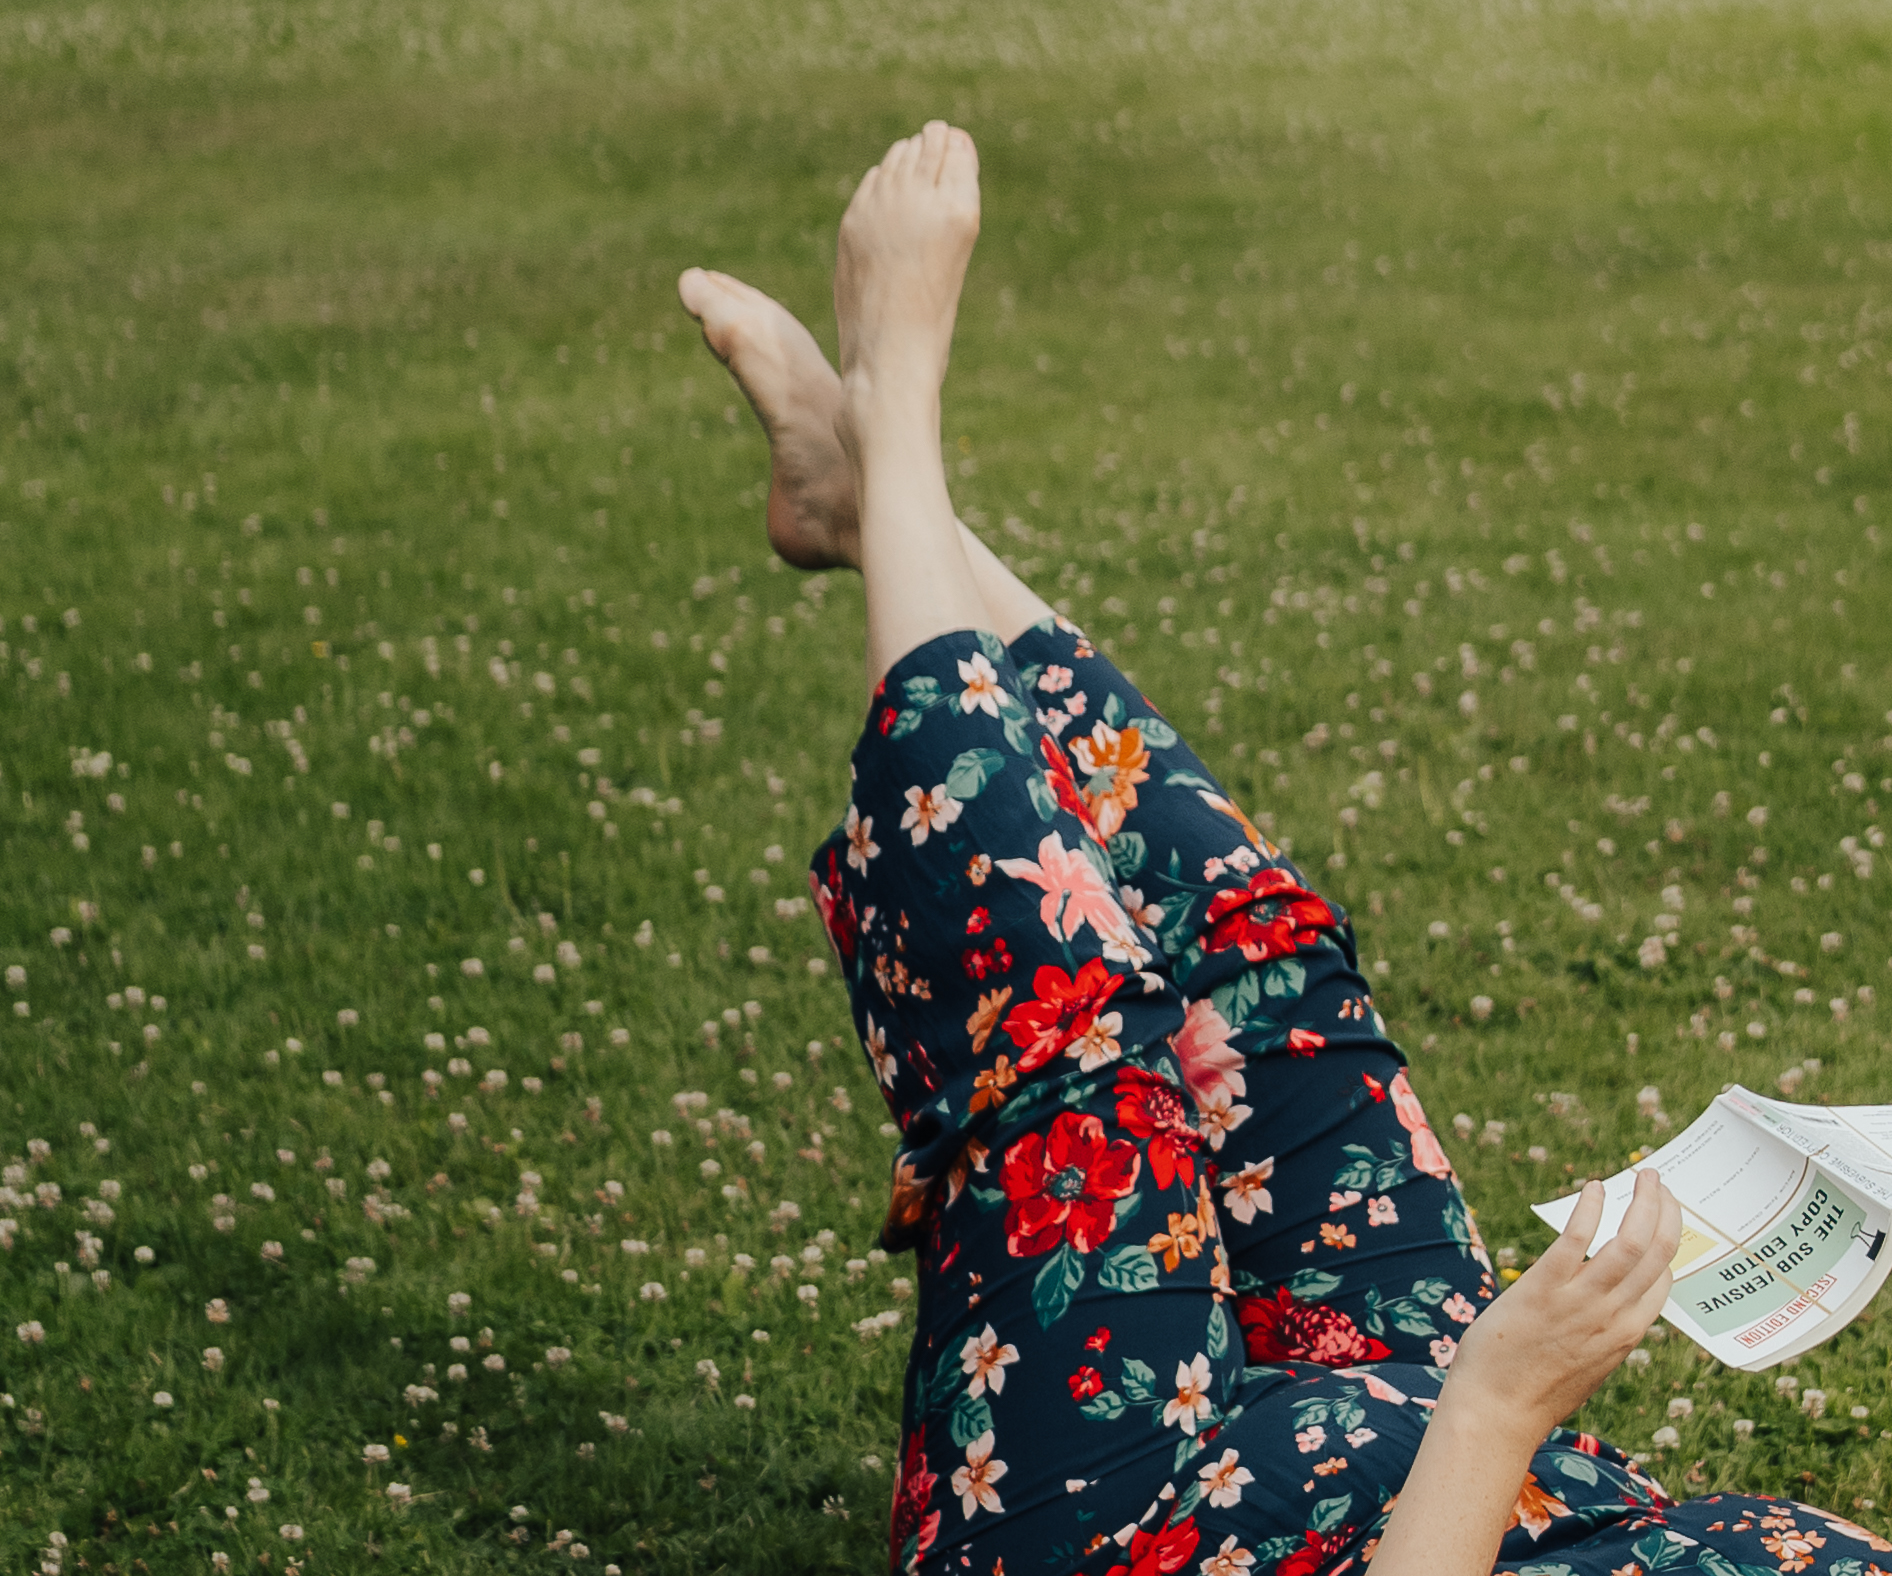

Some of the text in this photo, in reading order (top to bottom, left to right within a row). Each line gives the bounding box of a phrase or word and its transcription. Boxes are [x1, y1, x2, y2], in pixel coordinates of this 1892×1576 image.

[1718, 1188, 1828, 1281] COPY EDITOR
[1815, 1205, 1845, 1241] THE
[1742, 1310, 1790, 1345] EDITION
